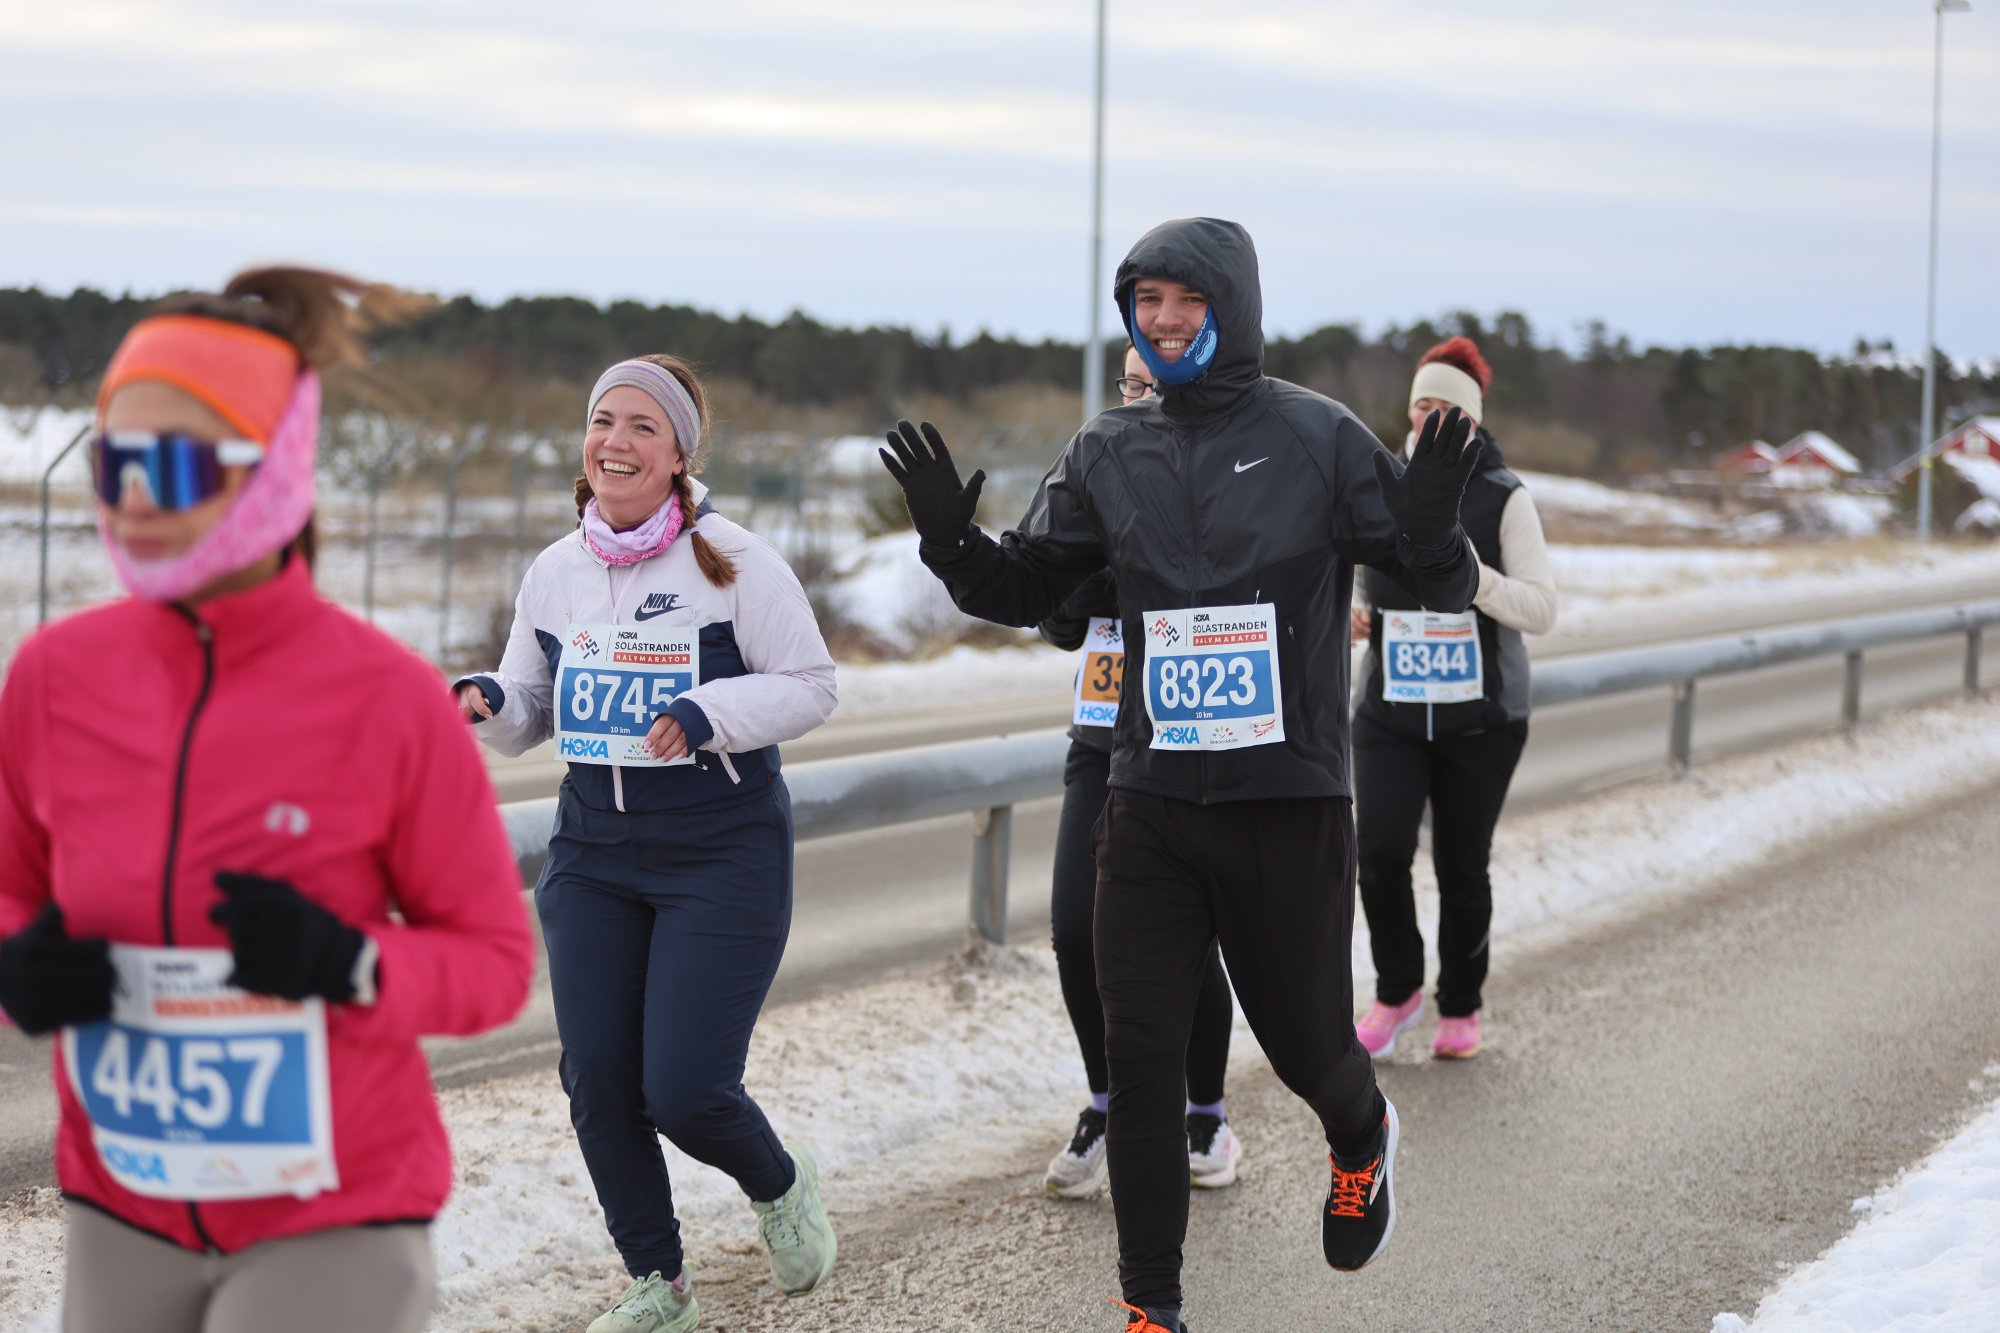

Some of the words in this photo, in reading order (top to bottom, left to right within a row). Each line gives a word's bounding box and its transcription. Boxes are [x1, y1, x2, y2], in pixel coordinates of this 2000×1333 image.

[643, 593, 680, 609] NIKE
[1193, 614, 1210, 622] HOKA
[1192, 620, 1267, 634] SOLASTRANDEN
[617, 631, 638, 640] HOKA
[1195, 634, 1265, 645] HALVMARATON
[614, 641, 691, 652] SOLASTRANDEN
[616, 653, 688, 663] HALVMARATON
[1396, 643, 1469, 676] 8344
[1159, 656, 1257, 709] 8323
[571, 672, 675, 723] 8745
[1080, 706, 1119, 722] HOK
[1196, 711, 1203, 719] 10
[610, 726, 618, 734] 10
[619, 726, 631, 734] km
[1159, 726, 1200, 744] HOKA
[560, 737, 609, 758] HOKA
[92, 1030, 283, 1128] 4457
